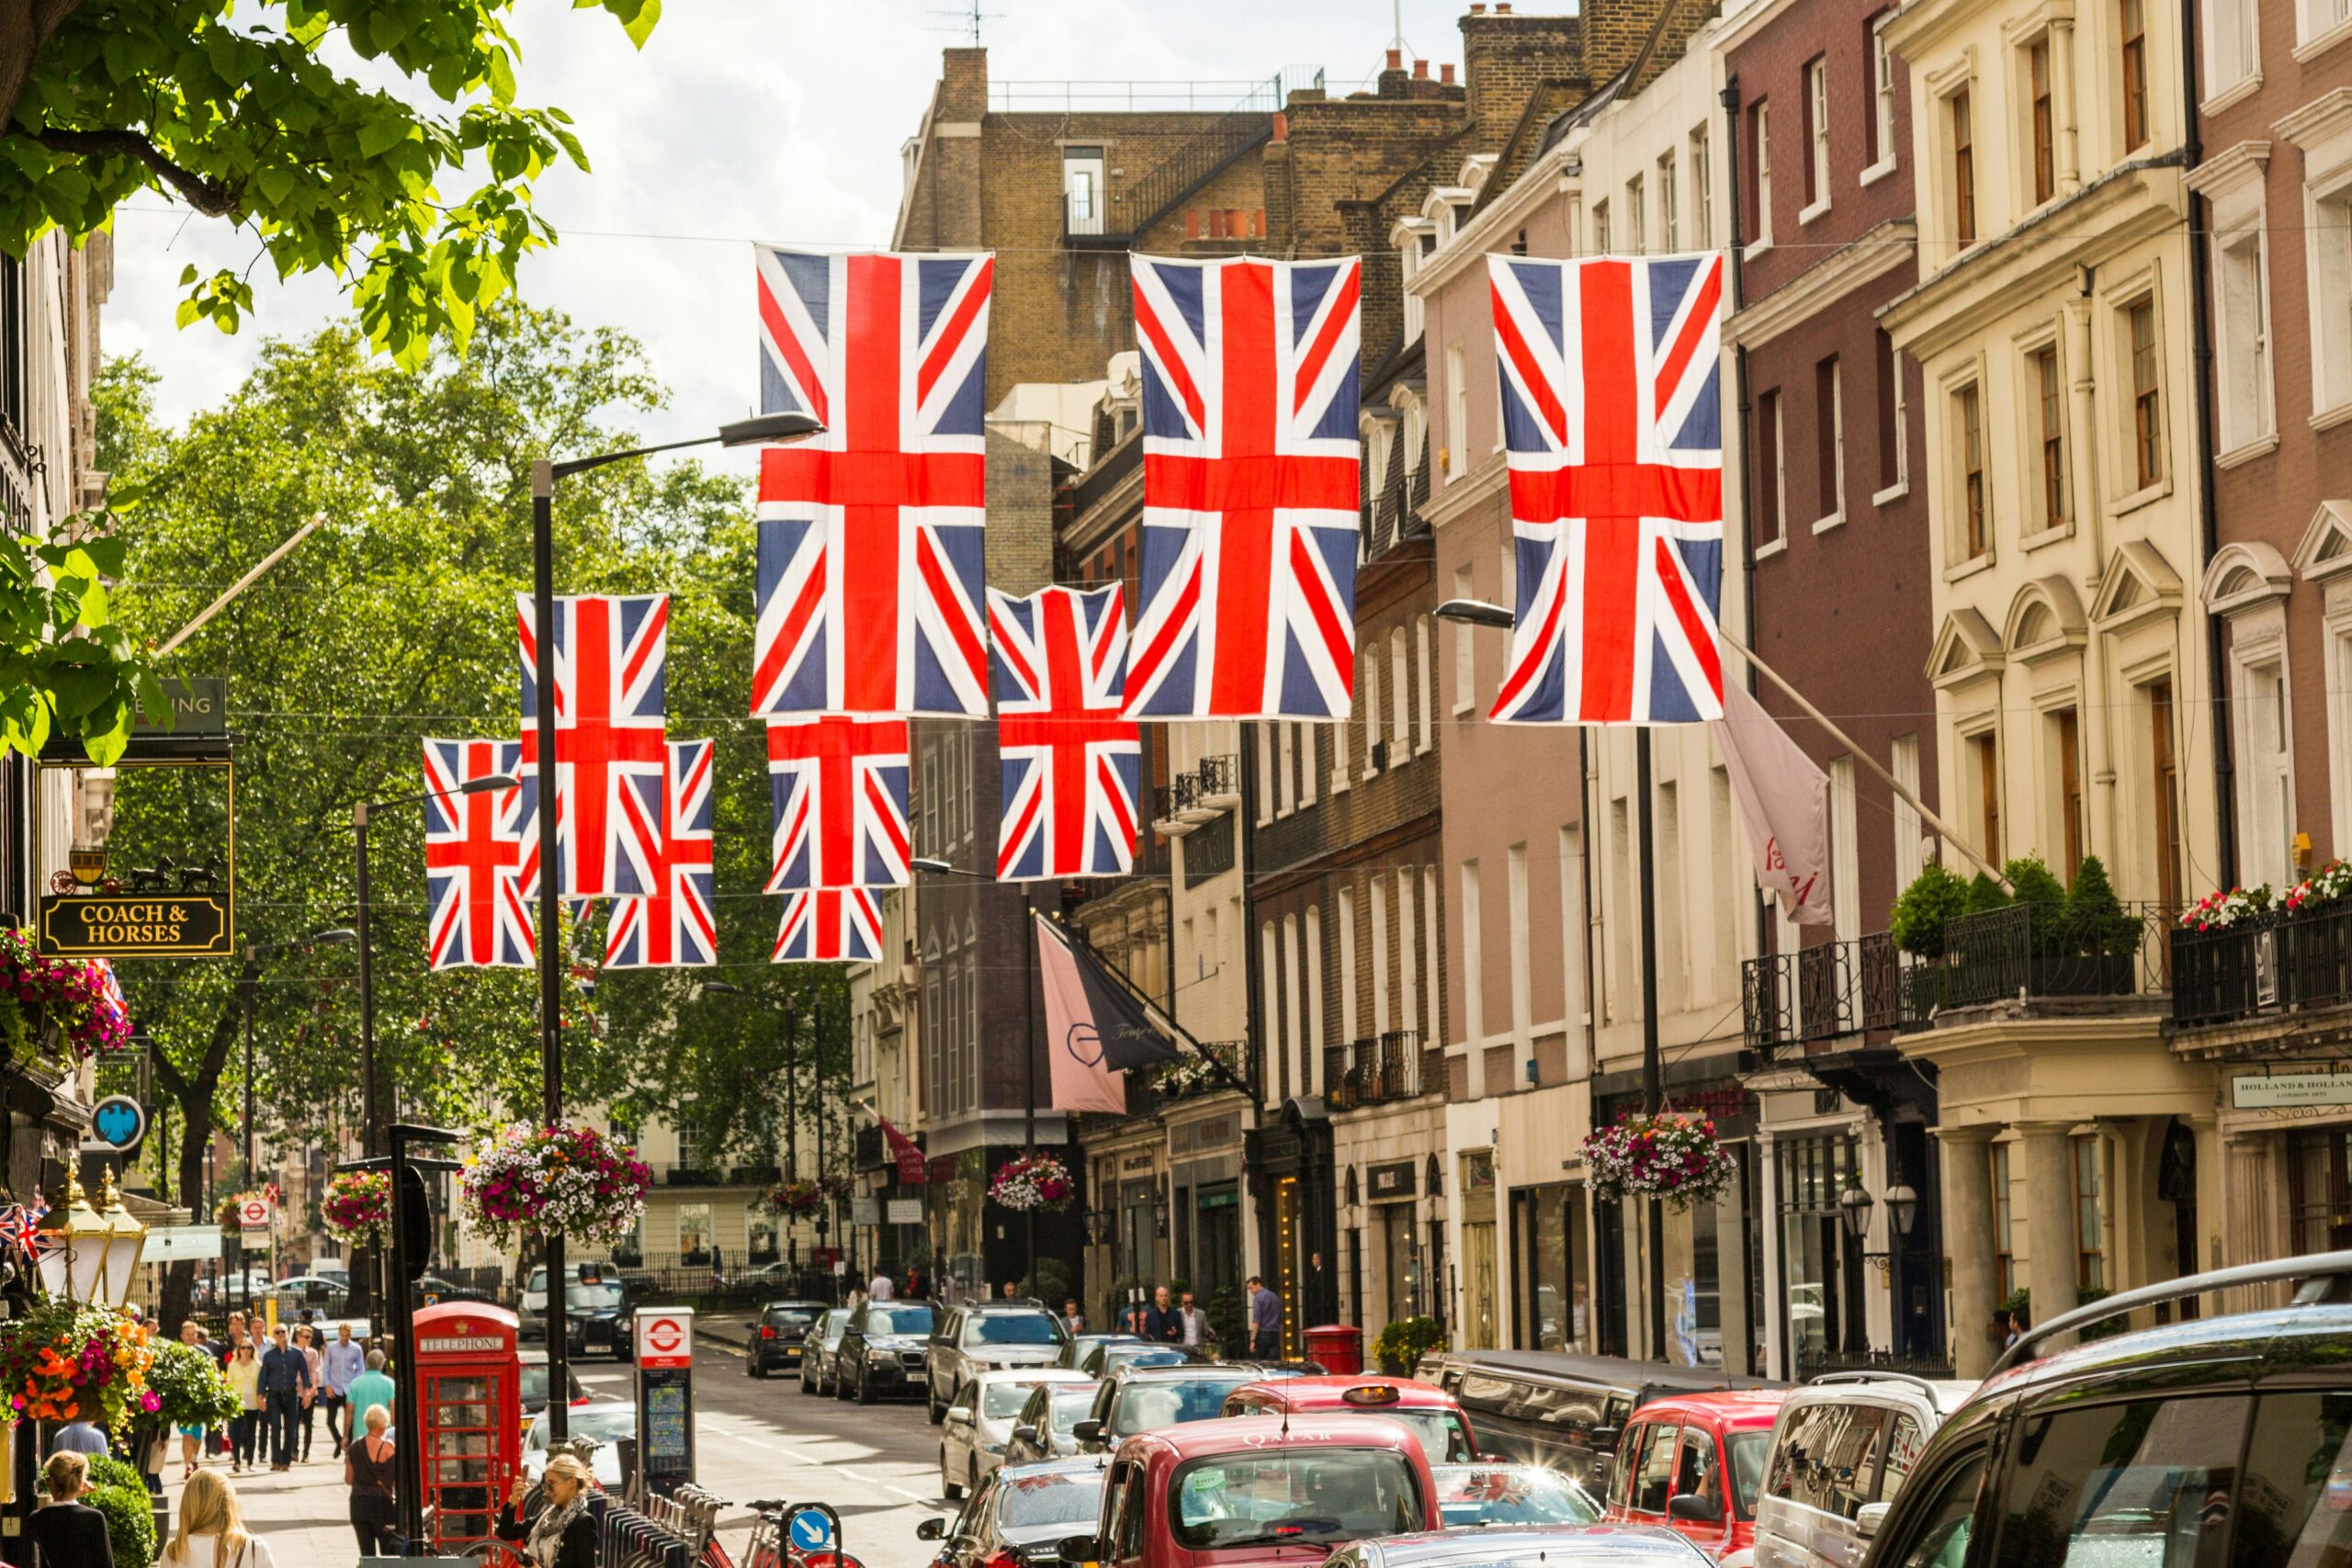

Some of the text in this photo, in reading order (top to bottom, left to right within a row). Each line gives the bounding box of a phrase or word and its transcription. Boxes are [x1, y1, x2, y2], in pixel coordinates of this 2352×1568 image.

[80, 905, 189, 923] COACH &
[87, 924, 181, 942] HORSES
[2241, 1082, 2296, 1091] HOLLAND
[425, 1337, 501, 1351] TELEPHONE
[1242, 1429, 1331, 1449] QATAR
